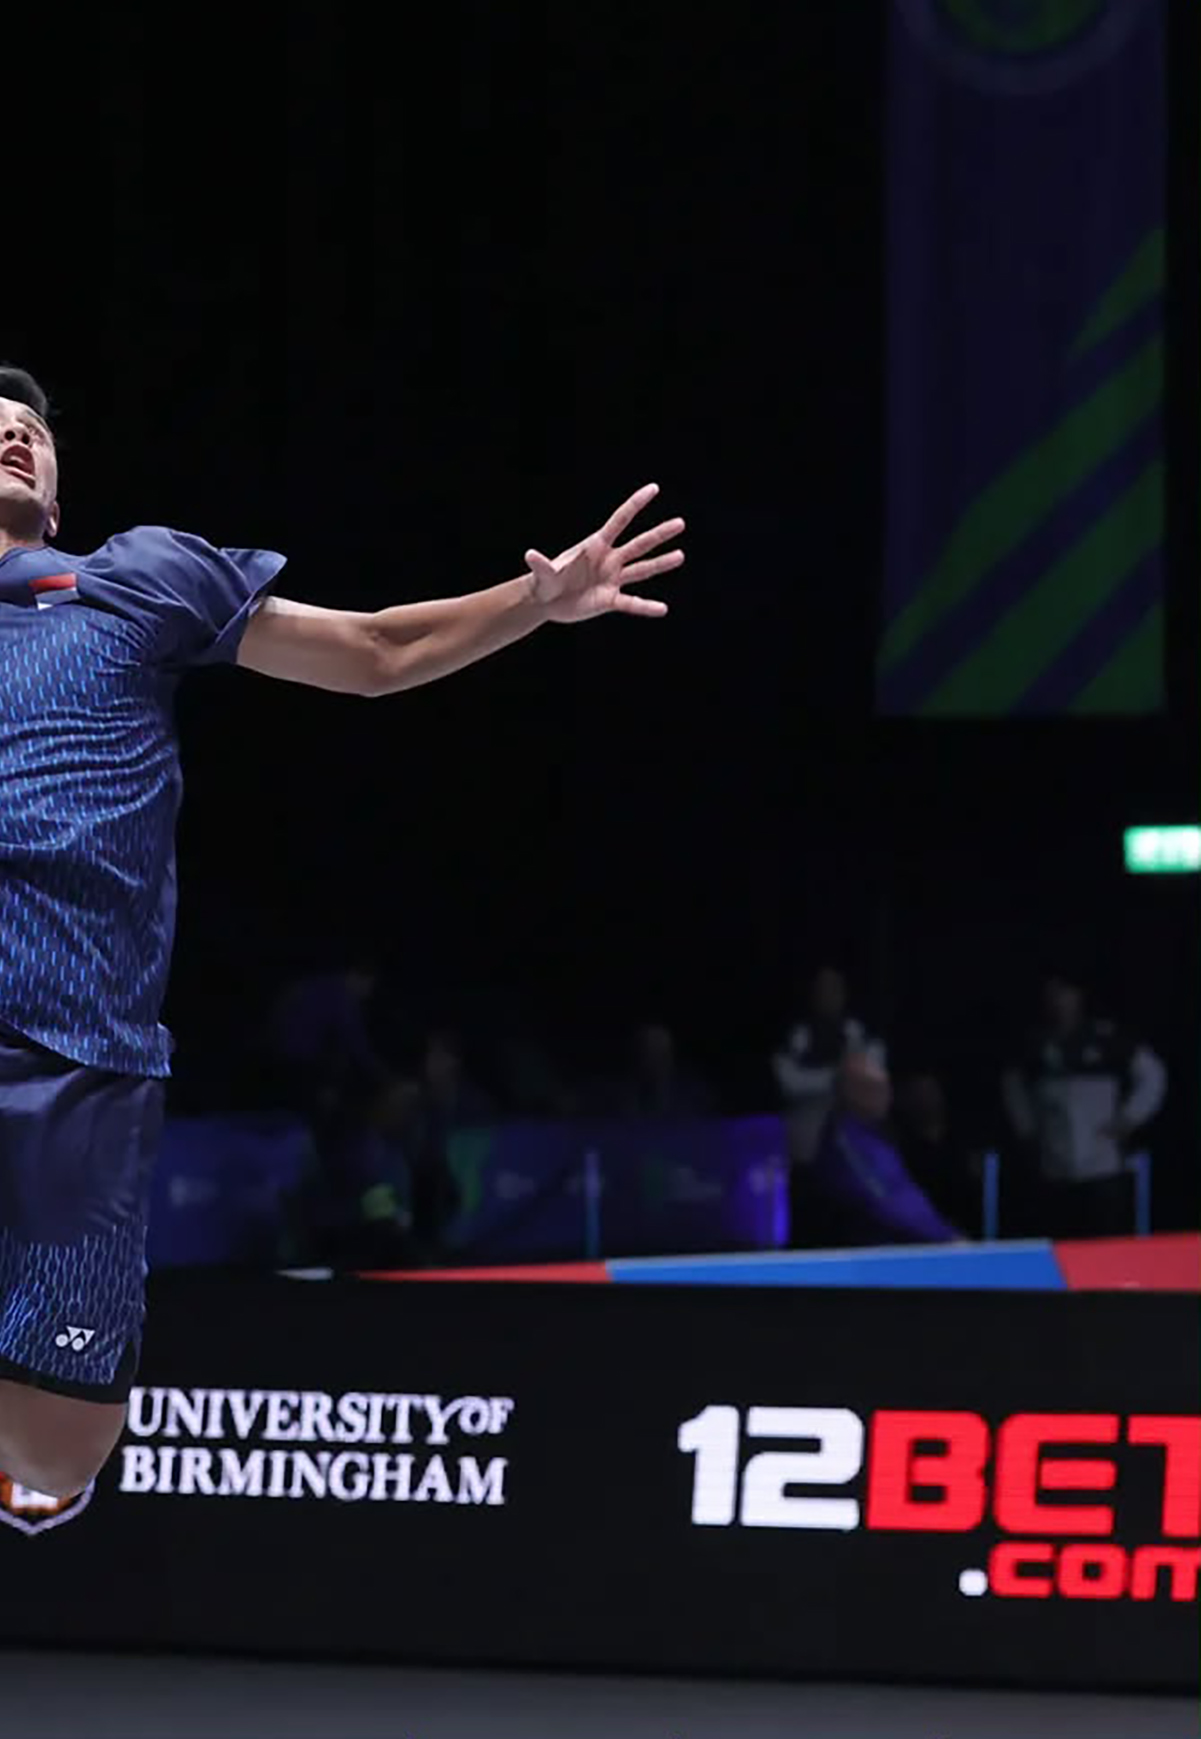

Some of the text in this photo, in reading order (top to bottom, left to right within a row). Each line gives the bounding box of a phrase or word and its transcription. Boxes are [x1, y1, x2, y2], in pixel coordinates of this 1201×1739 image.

[127, 1386, 515, 1445] UNIVERSITY OF
[119, 1445, 508, 1504] BIRMINGHAM
